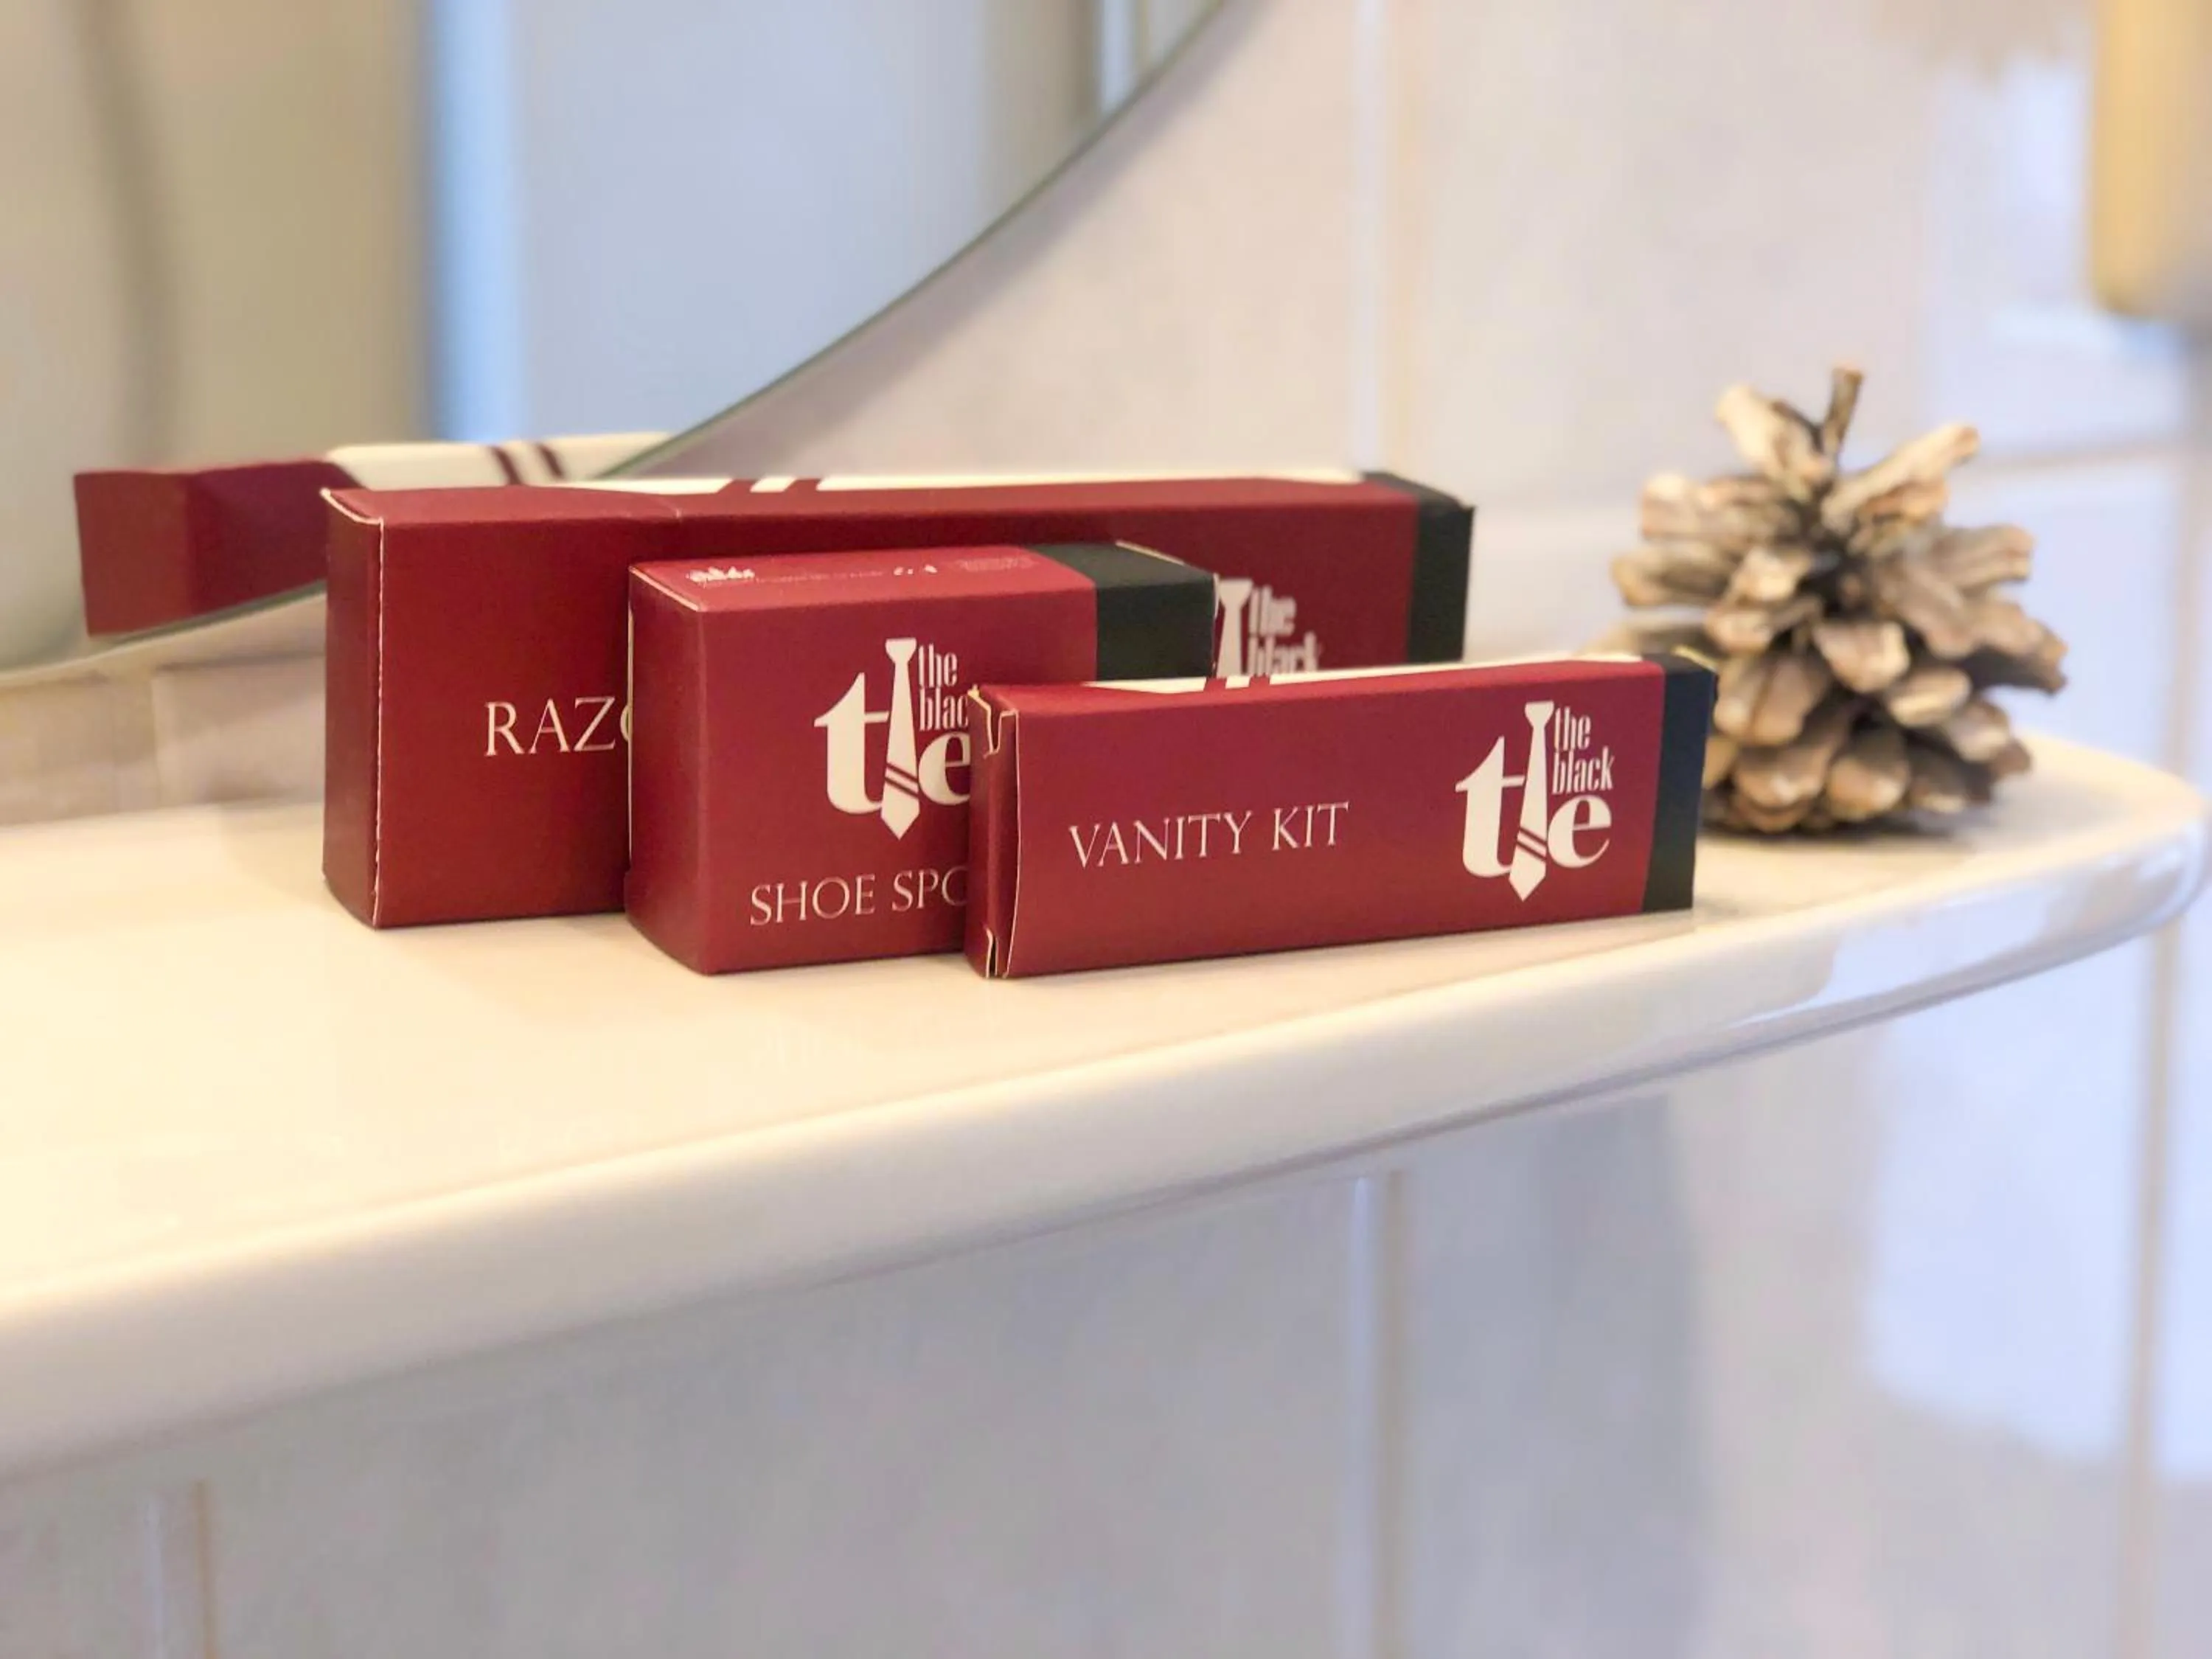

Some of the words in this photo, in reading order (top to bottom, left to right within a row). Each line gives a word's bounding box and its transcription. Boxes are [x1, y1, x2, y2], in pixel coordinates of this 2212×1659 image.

[1248, 585, 1296, 638] the
[918, 643, 958, 688] the
[1554, 706, 1591, 750] the
[1551, 745, 1615, 795] black
[1068, 810, 1252, 869] VANITY
[1271, 801, 1349, 851] KIT
[750, 873, 876, 926] SHOE
